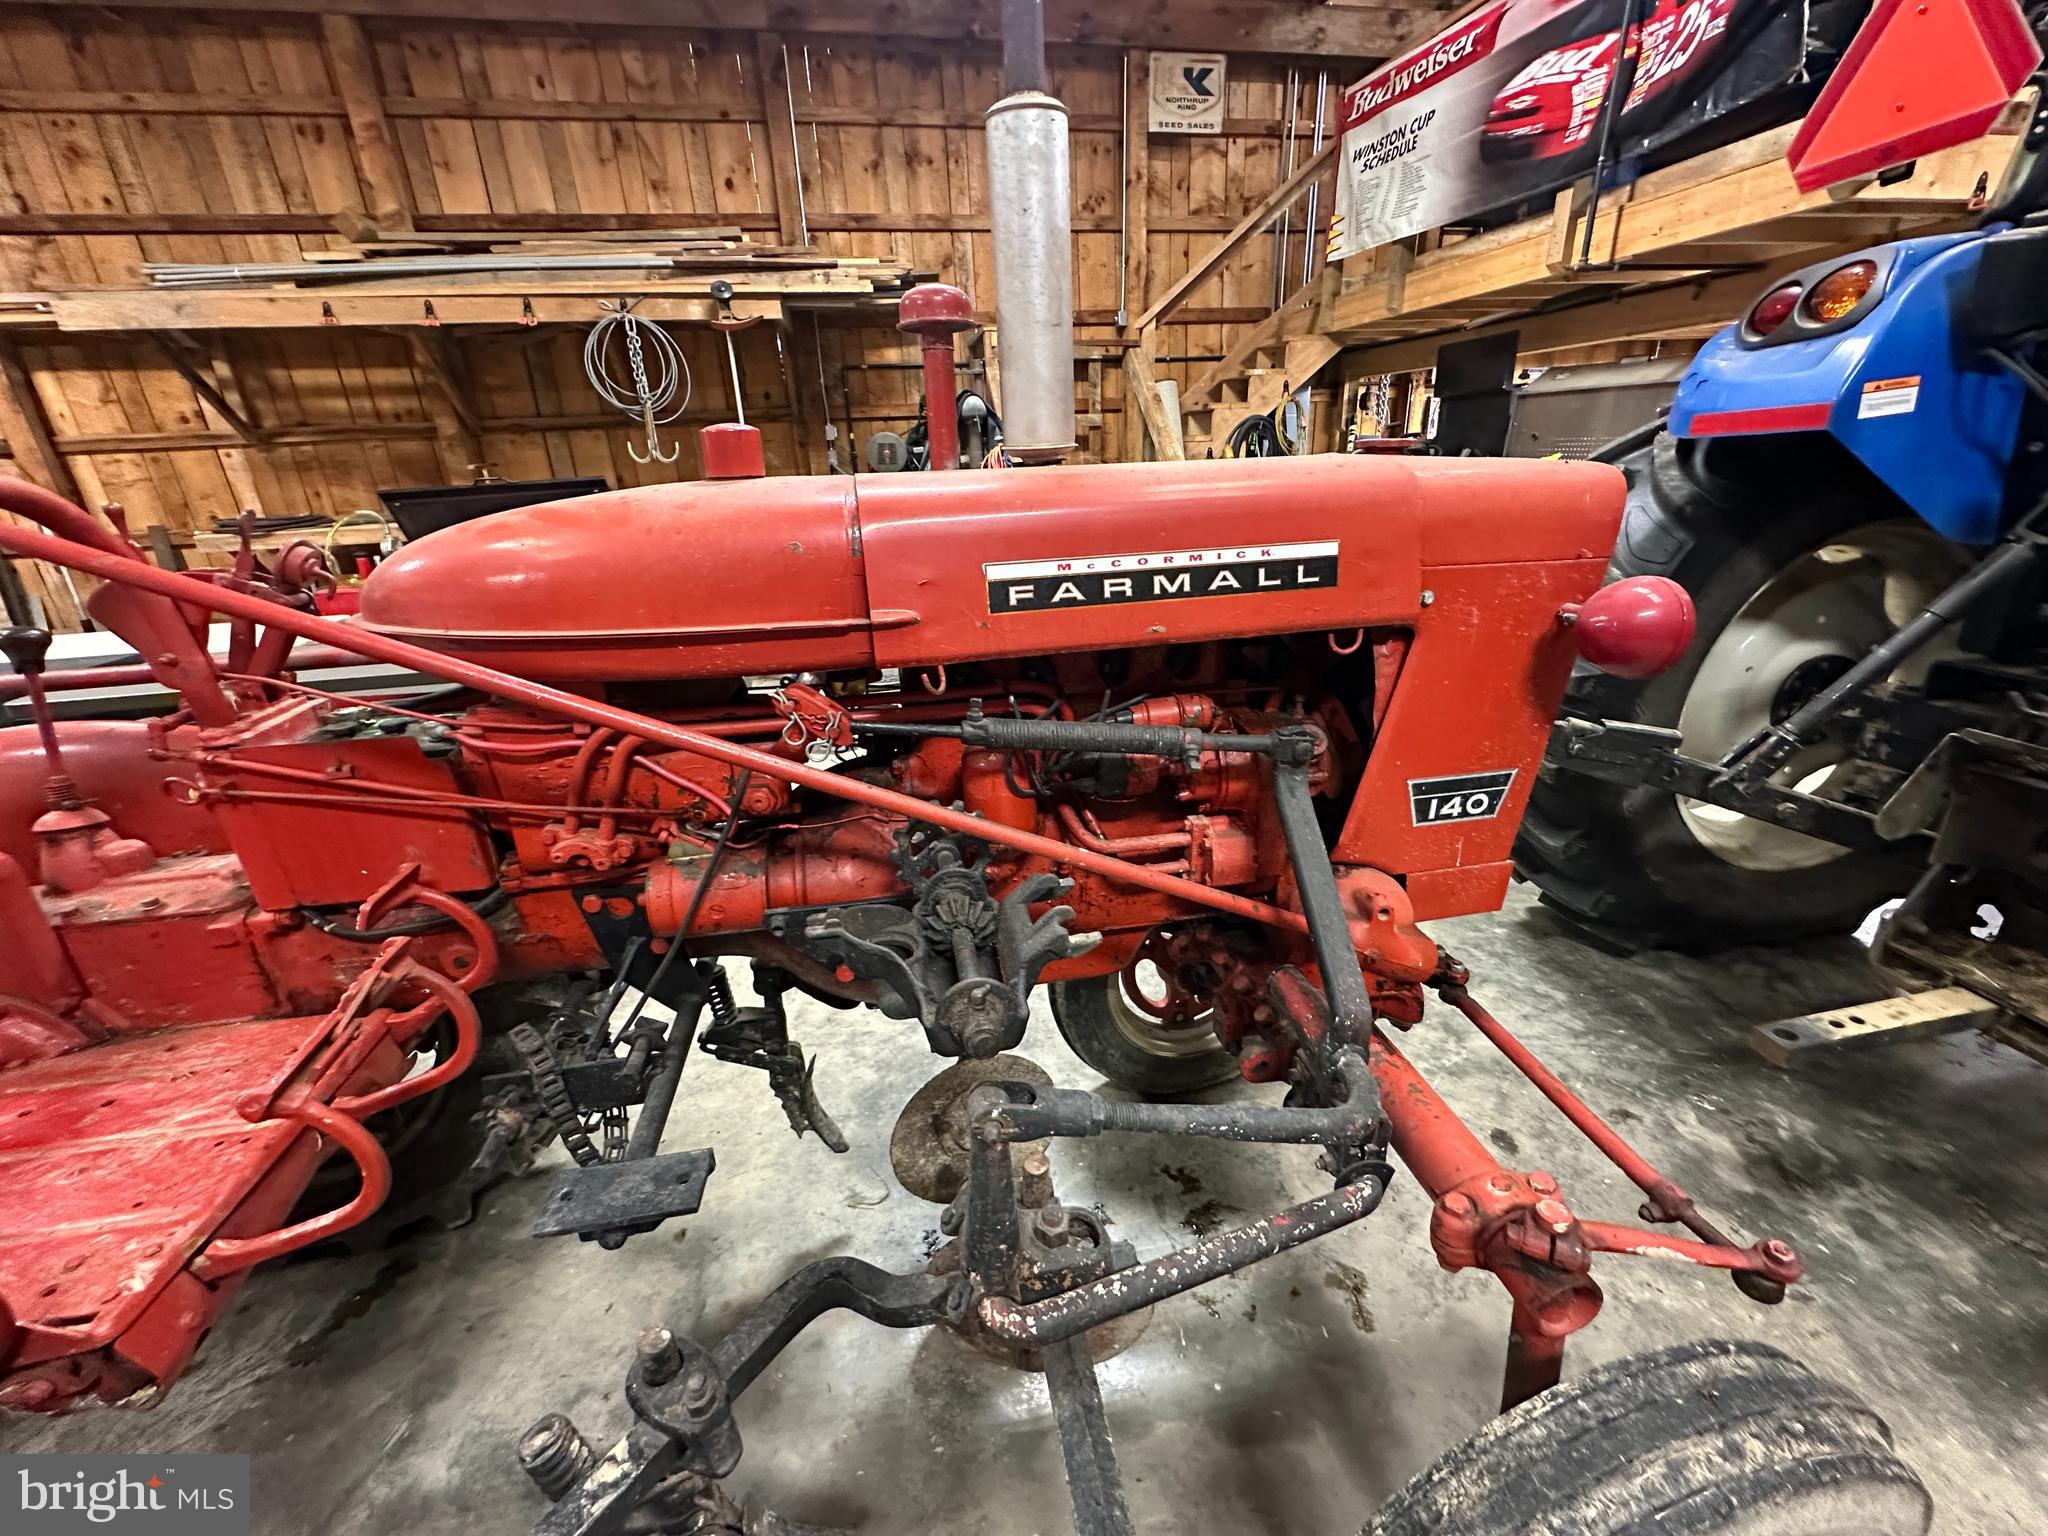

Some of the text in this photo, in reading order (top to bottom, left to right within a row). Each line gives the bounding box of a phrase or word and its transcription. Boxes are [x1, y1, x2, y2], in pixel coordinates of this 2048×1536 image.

[1347, 24, 1488, 122] Budweiser
[1165, 96, 1209, 104] NORTHRUP
[1158, 121, 1215, 130] SEED SALES
[1352, 109, 1436, 163] WINSTON CUP
[1360, 135, 1418, 173] SCHEDULE
[1008, 564, 1320, 607] FARMALL
[1428, 793, 1489, 820] 140
